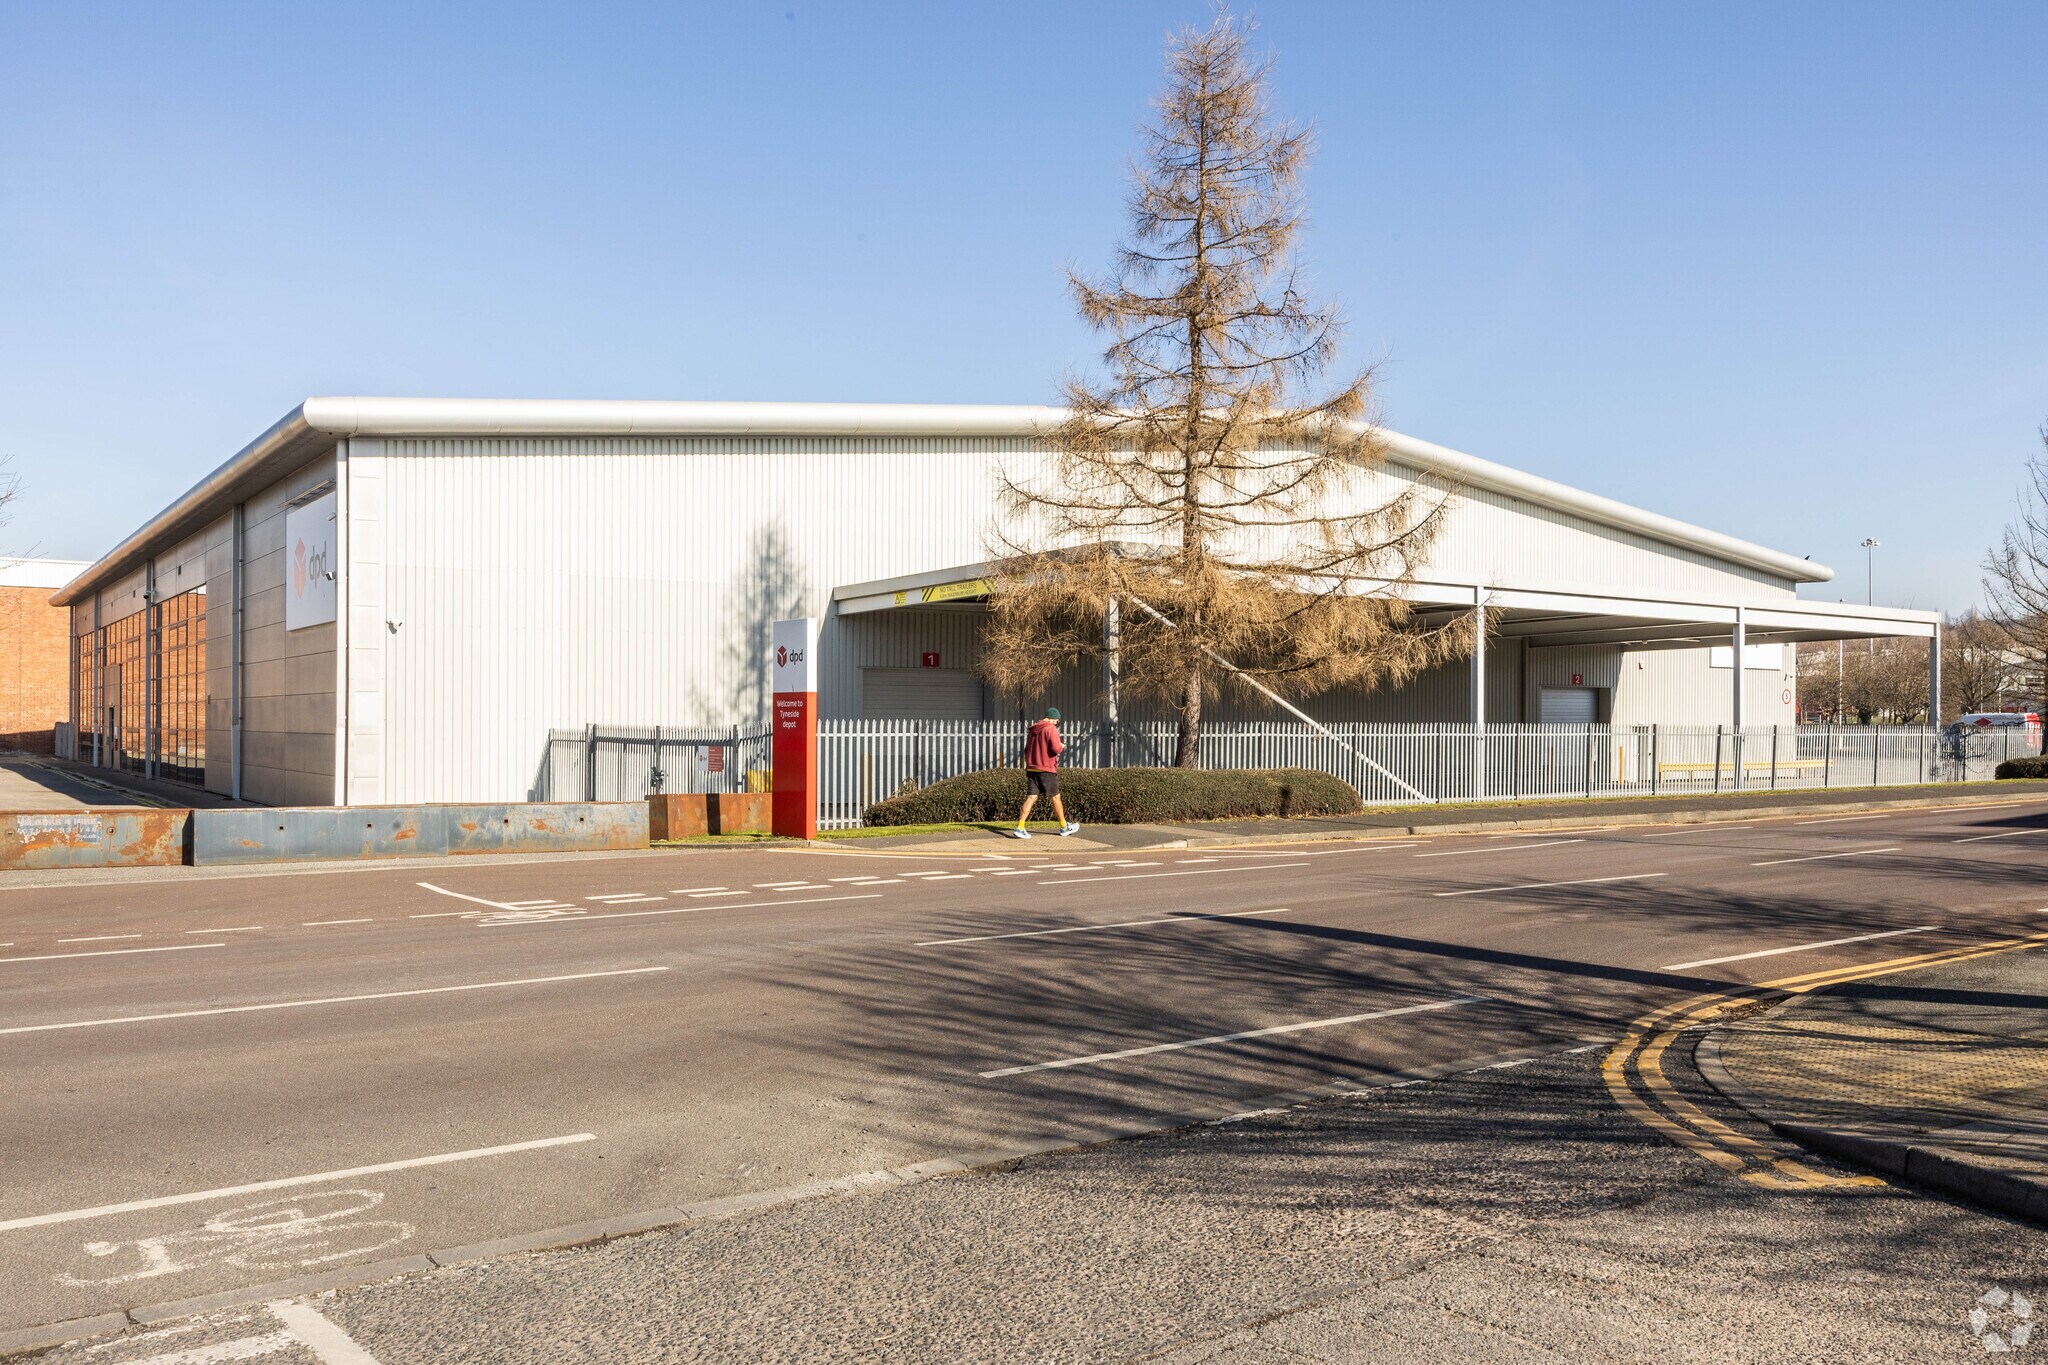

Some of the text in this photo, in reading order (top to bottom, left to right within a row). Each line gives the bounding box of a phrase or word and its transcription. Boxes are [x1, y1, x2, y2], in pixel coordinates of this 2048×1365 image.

[309, 540, 326, 588] dpd
[957, 582, 977, 590] TRAILERS
[789, 649, 803, 665] dpd
[928, 655, 934, 665] 1
[1575, 675, 1581, 684] 2
[780, 710, 800, 719] Tyneside
[782, 720, 797, 729] depot
